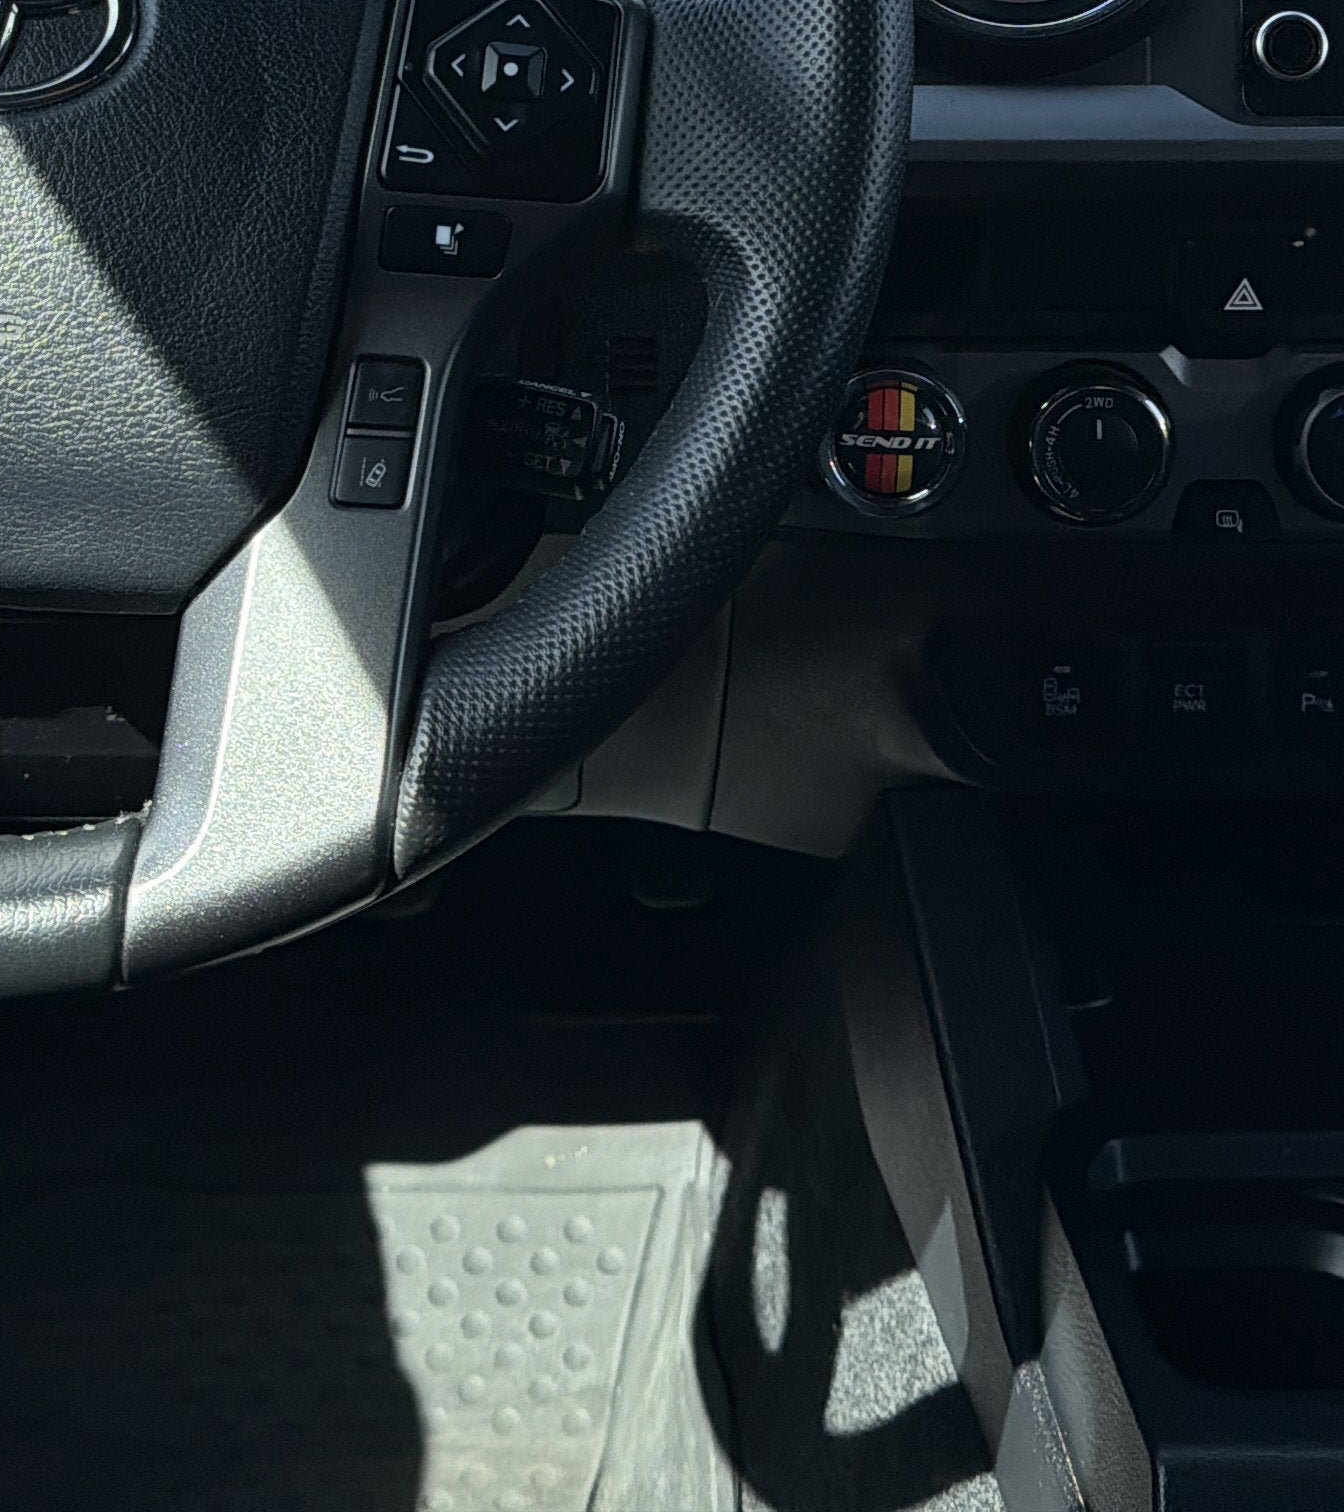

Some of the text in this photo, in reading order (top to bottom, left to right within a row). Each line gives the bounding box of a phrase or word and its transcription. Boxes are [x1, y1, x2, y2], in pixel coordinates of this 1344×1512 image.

[536, 397, 566, 417] RES
[1084, 396, 1114, 409] 2WD
[839, 433, 942, 450] SEND IT
[1174, 684, 1205, 699] ECT
[1045, 703, 1077, 716] BSM
[1172, 699, 1206, 712] PWR
